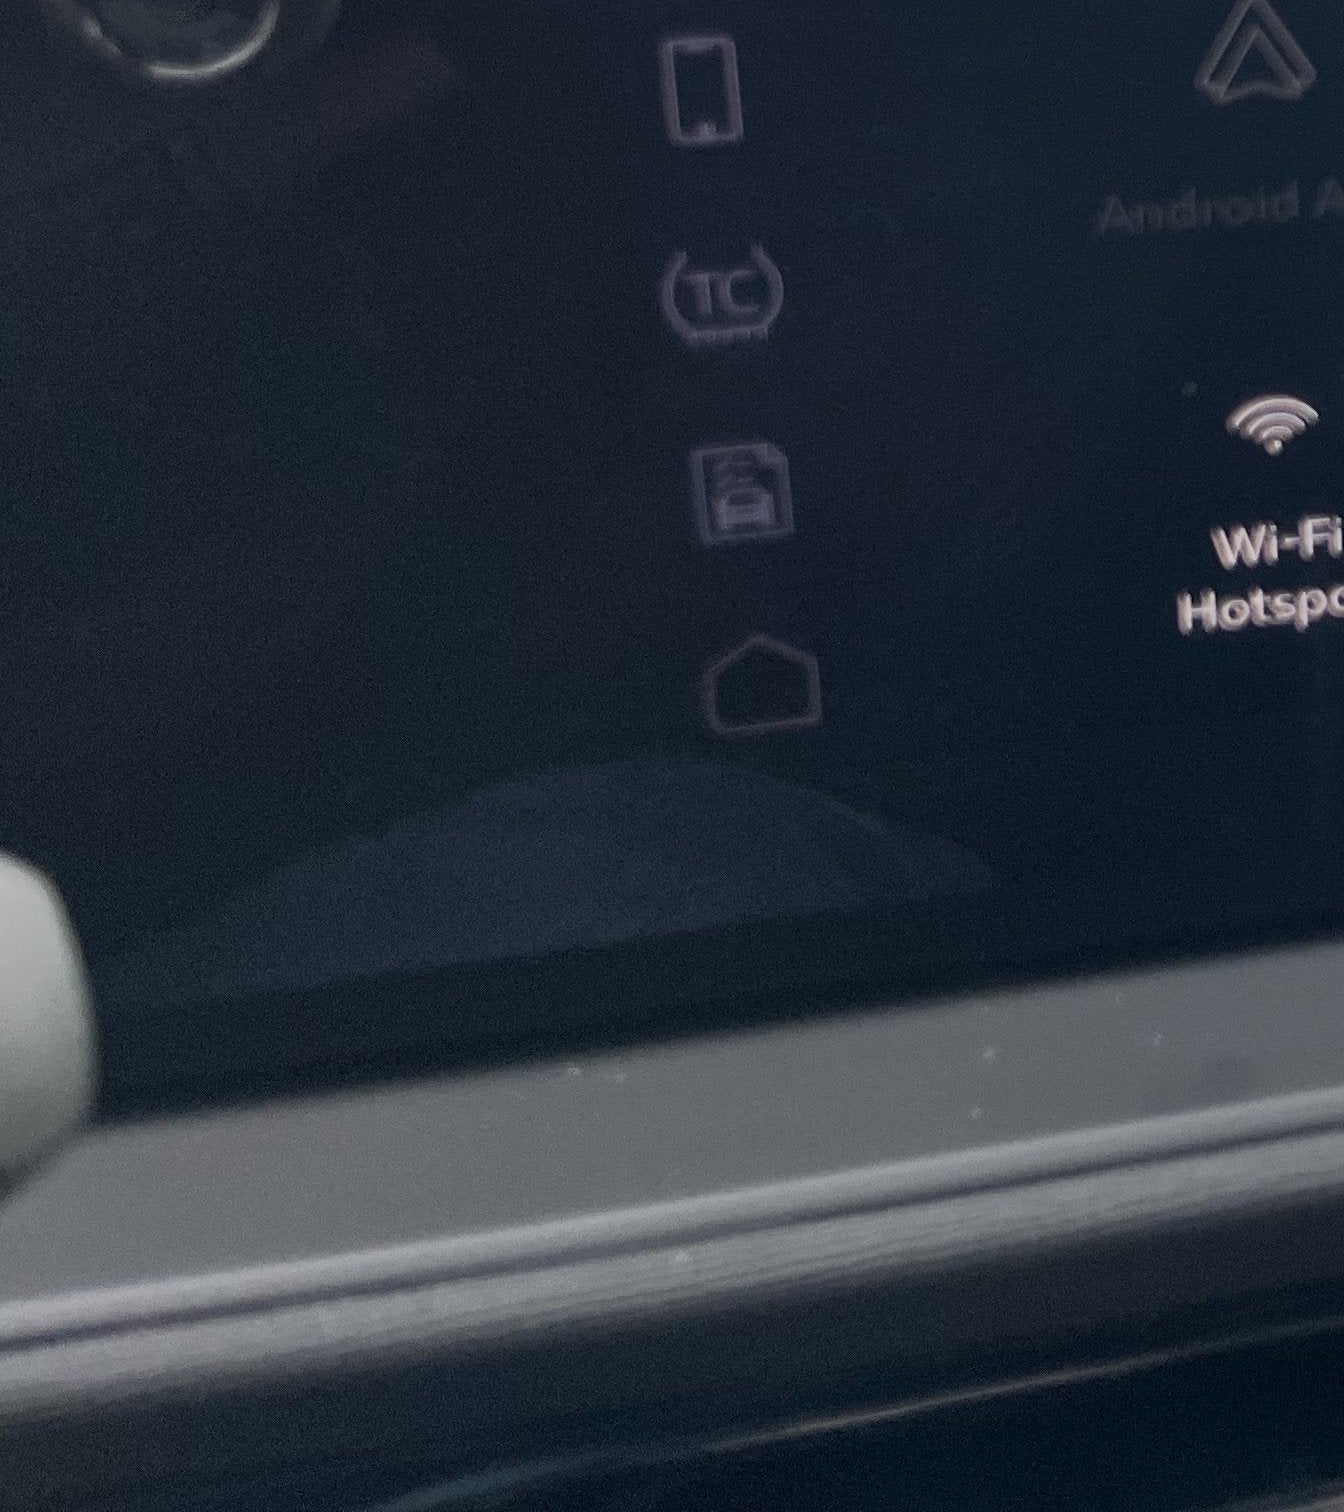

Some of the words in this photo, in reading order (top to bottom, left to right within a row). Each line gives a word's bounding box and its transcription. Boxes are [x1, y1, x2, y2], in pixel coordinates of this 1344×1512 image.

[1096, 181, 1300, 235] Android
[690, 270, 759, 315] TC
[1211, 514, 1344, 571] Wi-Fi
